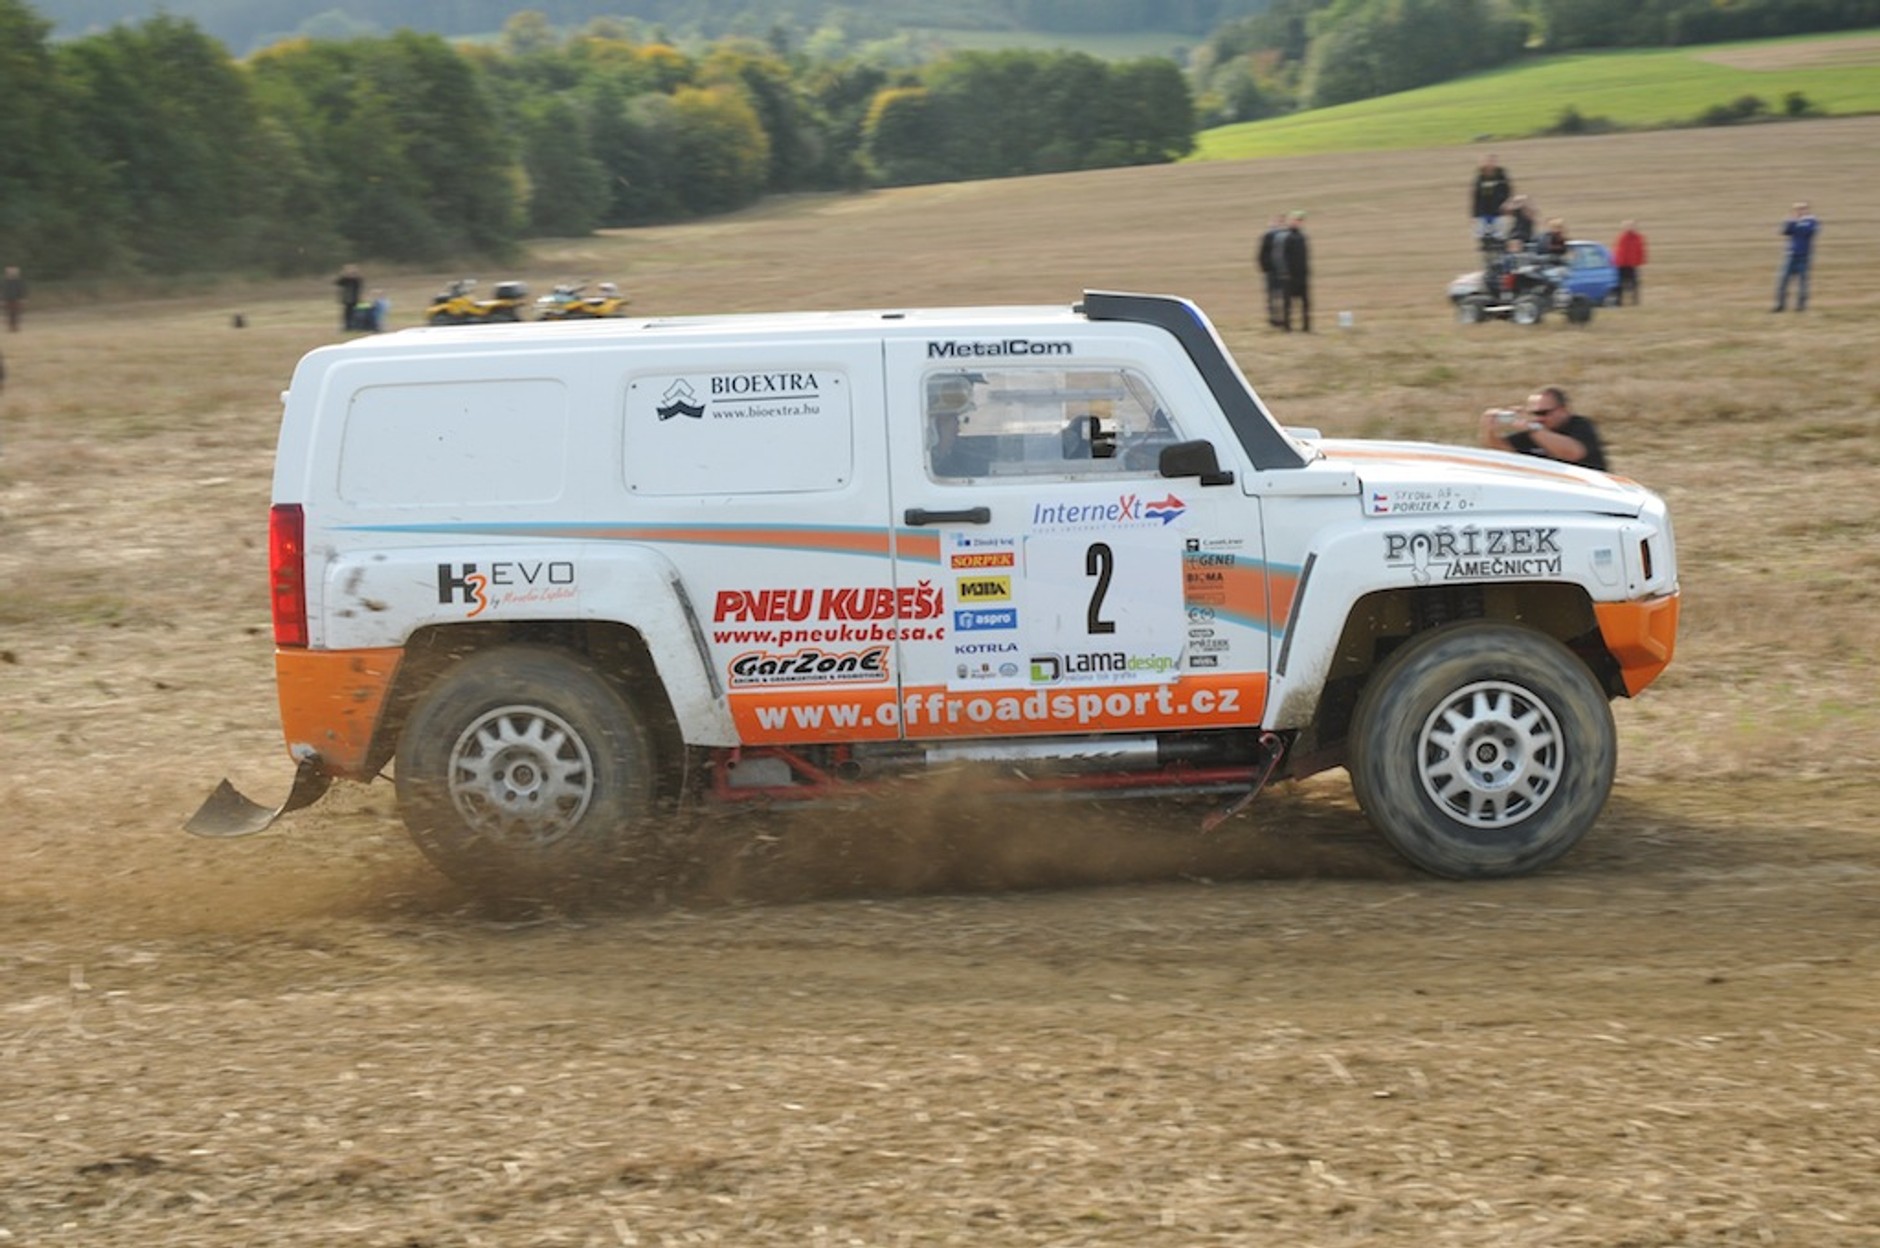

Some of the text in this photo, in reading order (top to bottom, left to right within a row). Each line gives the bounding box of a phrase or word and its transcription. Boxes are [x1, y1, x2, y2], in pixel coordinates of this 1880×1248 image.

[927, 339, 1073, 359] MetalCom
[711, 373, 818, 394] BIOEXTRA
[712, 404, 820, 418] www.bioextra.hu
[1033, 493, 1142, 525] InterneXt
[492, 562, 574, 585] EVO
[1085, 542, 1116, 634] 2
[713, 588, 815, 623] PNEU
[975, 613, 1011, 626] aspro
[714, 624, 945, 648] www.pneukubesa.c
[955, 643, 1018, 654] KOTRLA
[754, 685, 1241, 731] www.offroadsport.cz
